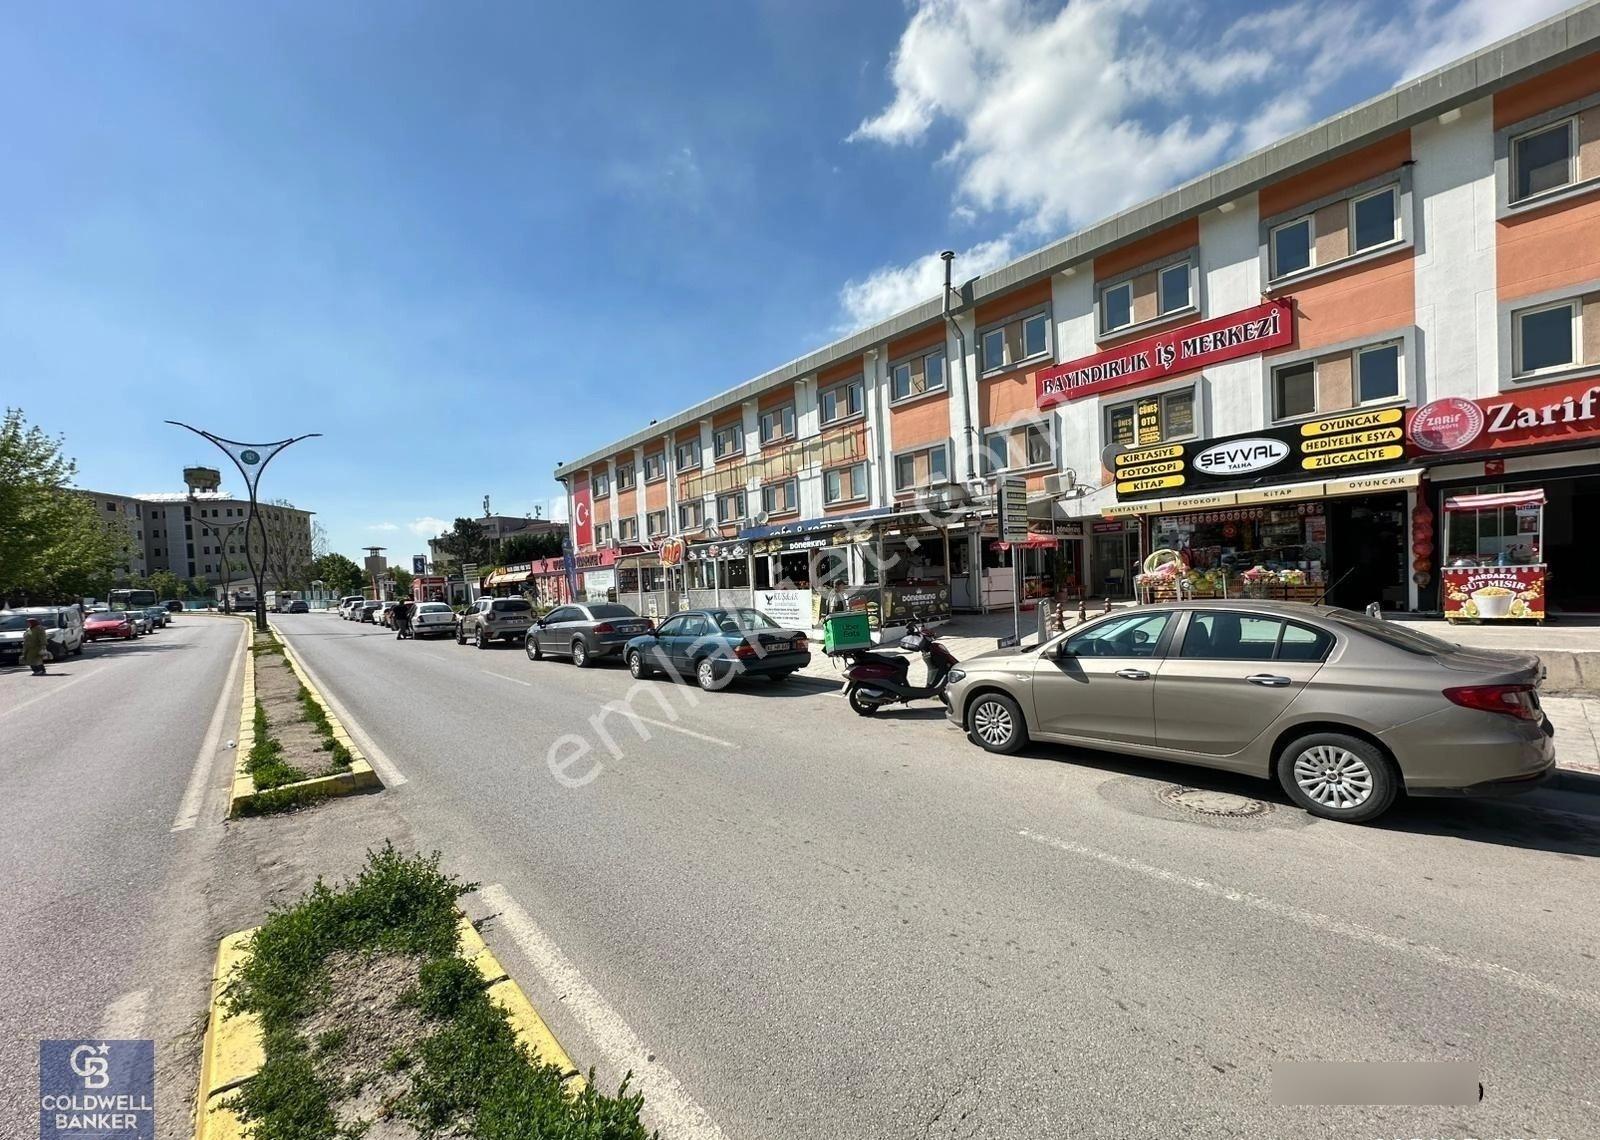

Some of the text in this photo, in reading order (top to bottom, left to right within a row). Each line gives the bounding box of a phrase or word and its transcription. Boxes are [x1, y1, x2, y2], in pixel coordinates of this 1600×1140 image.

[1042, 308, 1280, 396] BAYINDIRLIK İŞ MERKEZİ
[1139, 403, 1158, 415] GÜNEŞ
[1487, 387, 1600, 432] Zarif
[1141, 416, 1156, 426] OTO
[1320, 414, 1380, 431] OYUNCAK
[1306, 430, 1395, 450] HEDİYELİK EŞYA
[1123, 447, 1175, 463] KIRTASİYE
[1201, 445, 1281, 469] ŞEVVAL
[1316, 449, 1384, 466] ZÜCCACİYE
[1122, 462, 1176, 478] FOTOKOPİ
[1133, 479, 1164, 490] KİTAP
[1178, 497, 1221, 507] FOTOKOPİ
[1264, 489, 1292, 498] KİTAP
[1350, 477, 1404, 488] OYUNCAK
[1460, 579, 1527, 592] SÜT MISIR
[1468, 573, 1517, 583] BARDAKTA
